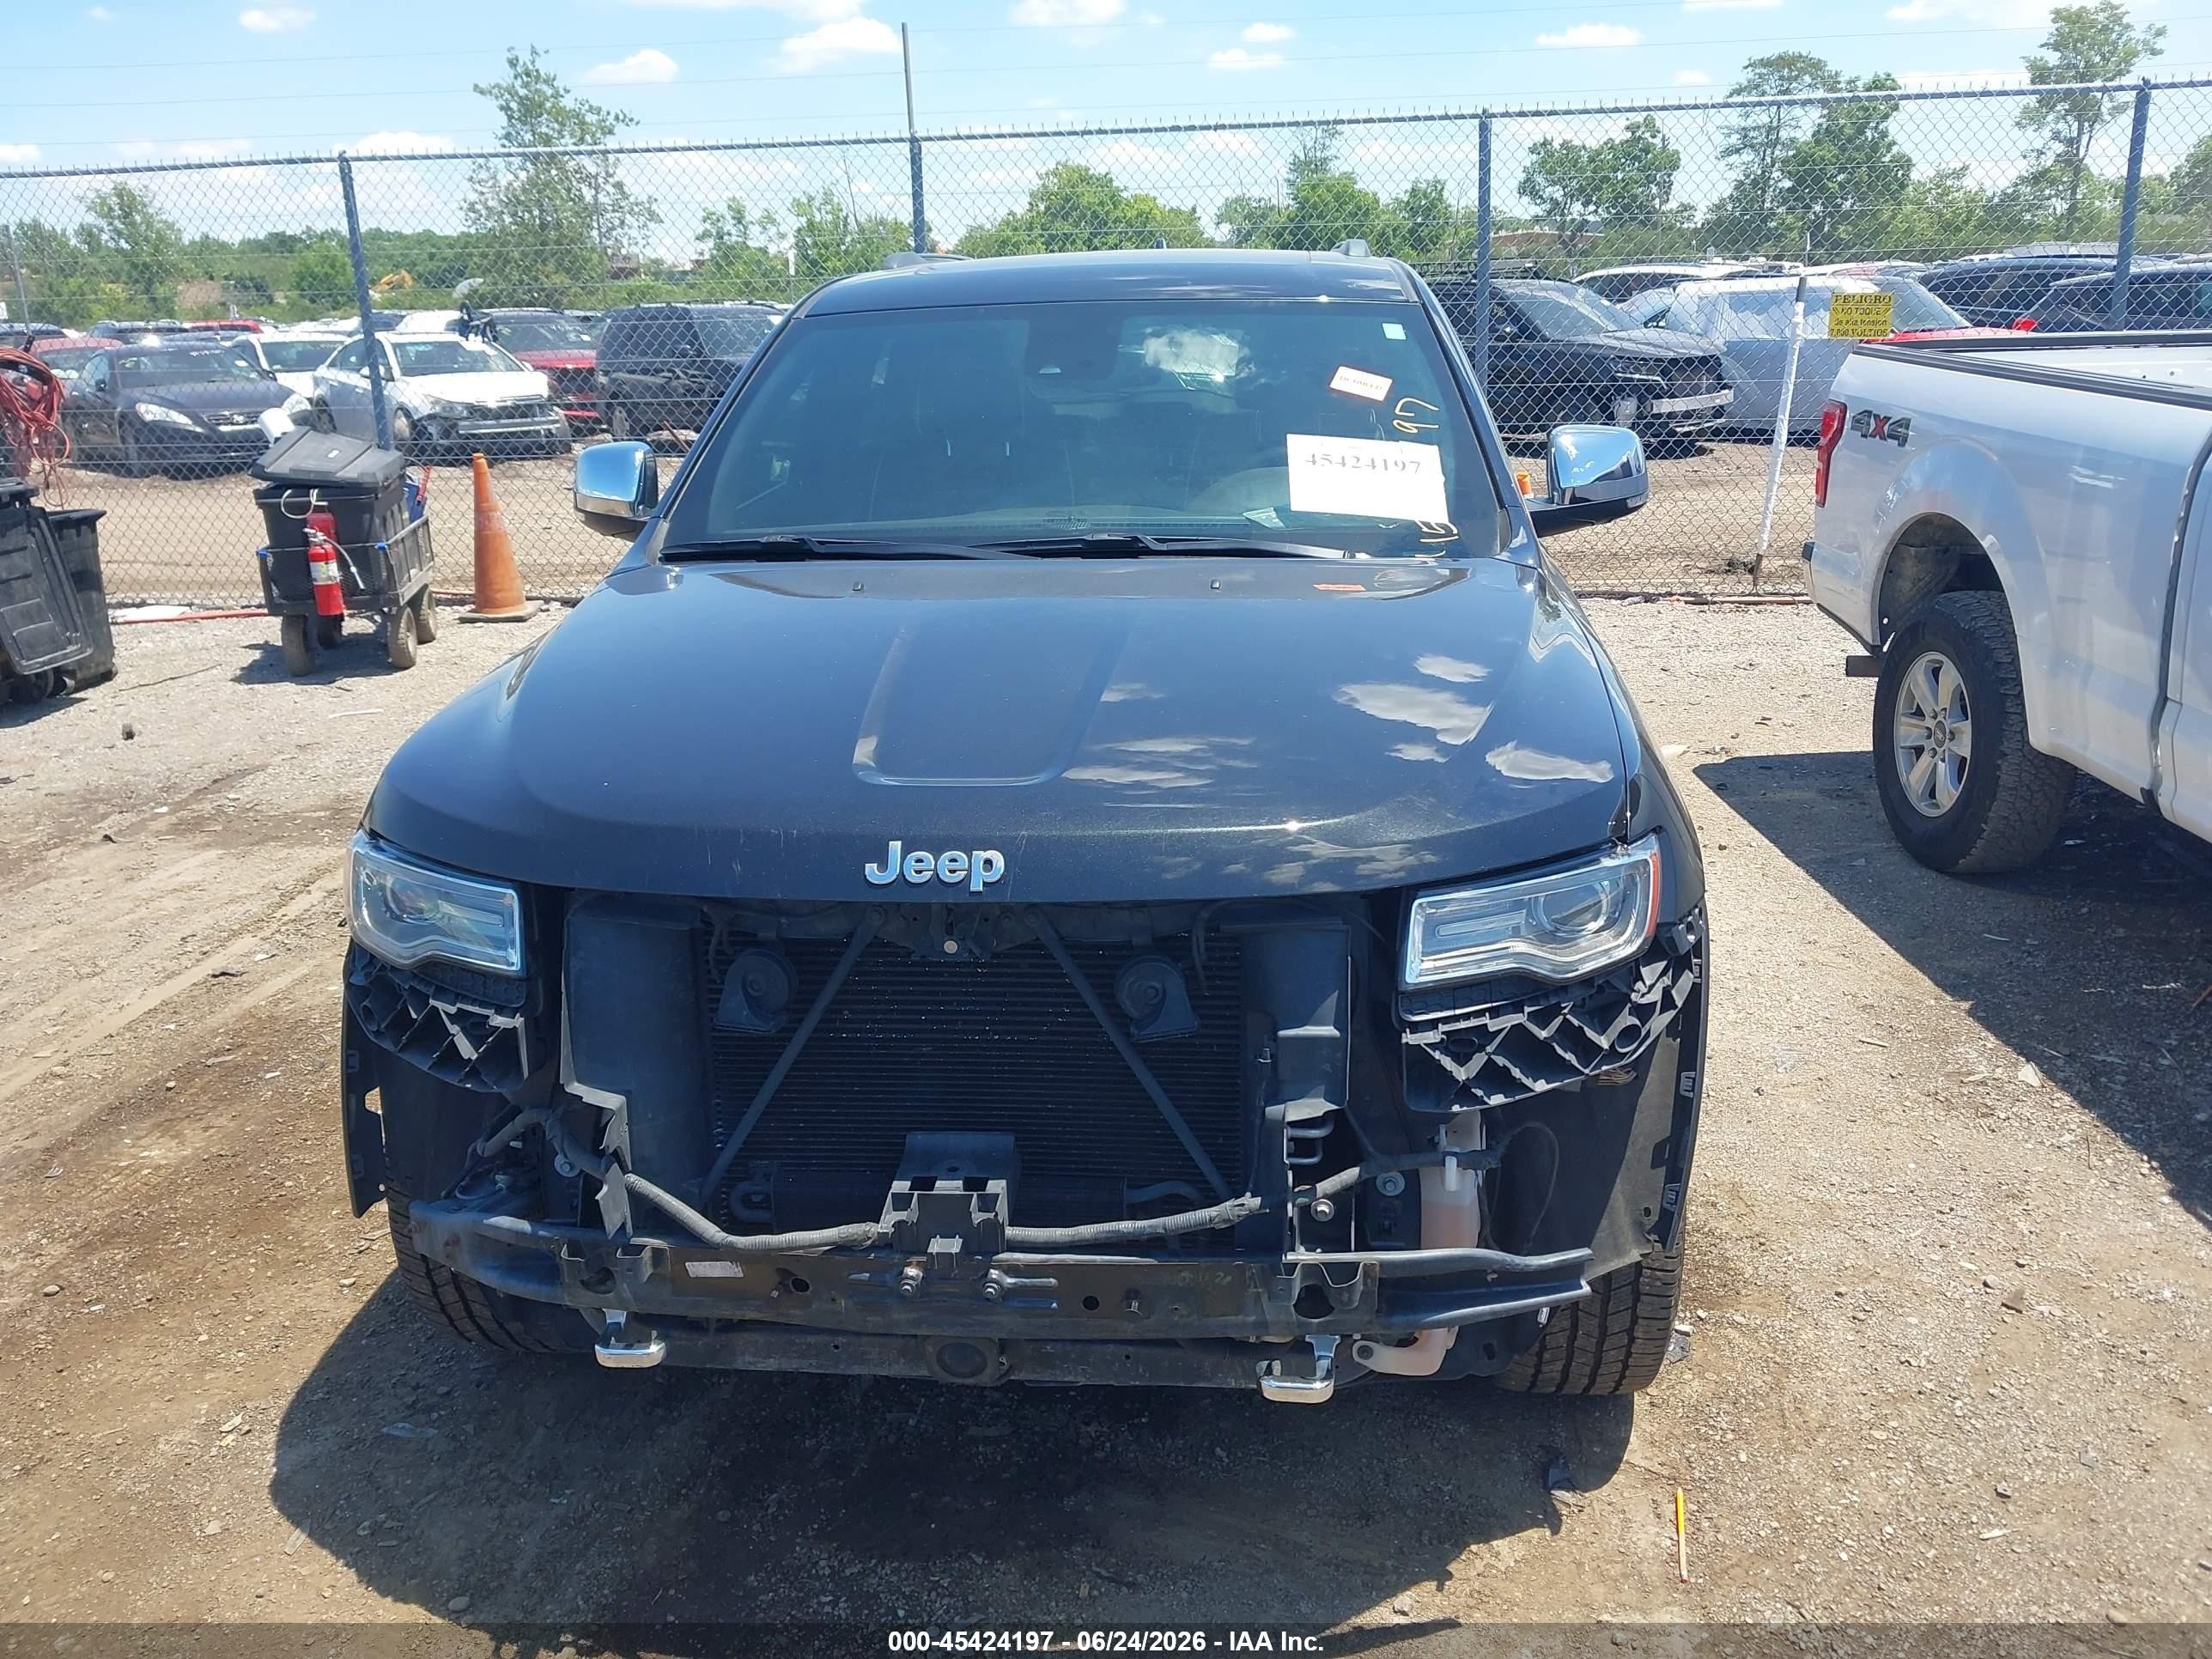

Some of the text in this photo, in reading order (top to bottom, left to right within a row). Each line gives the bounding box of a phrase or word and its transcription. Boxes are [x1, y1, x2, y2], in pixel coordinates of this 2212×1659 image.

[1834, 295, 1892, 304] PELIGRO
[1305, 453, 1421, 474] 45424197
[865, 840, 1005, 892] Jeep
